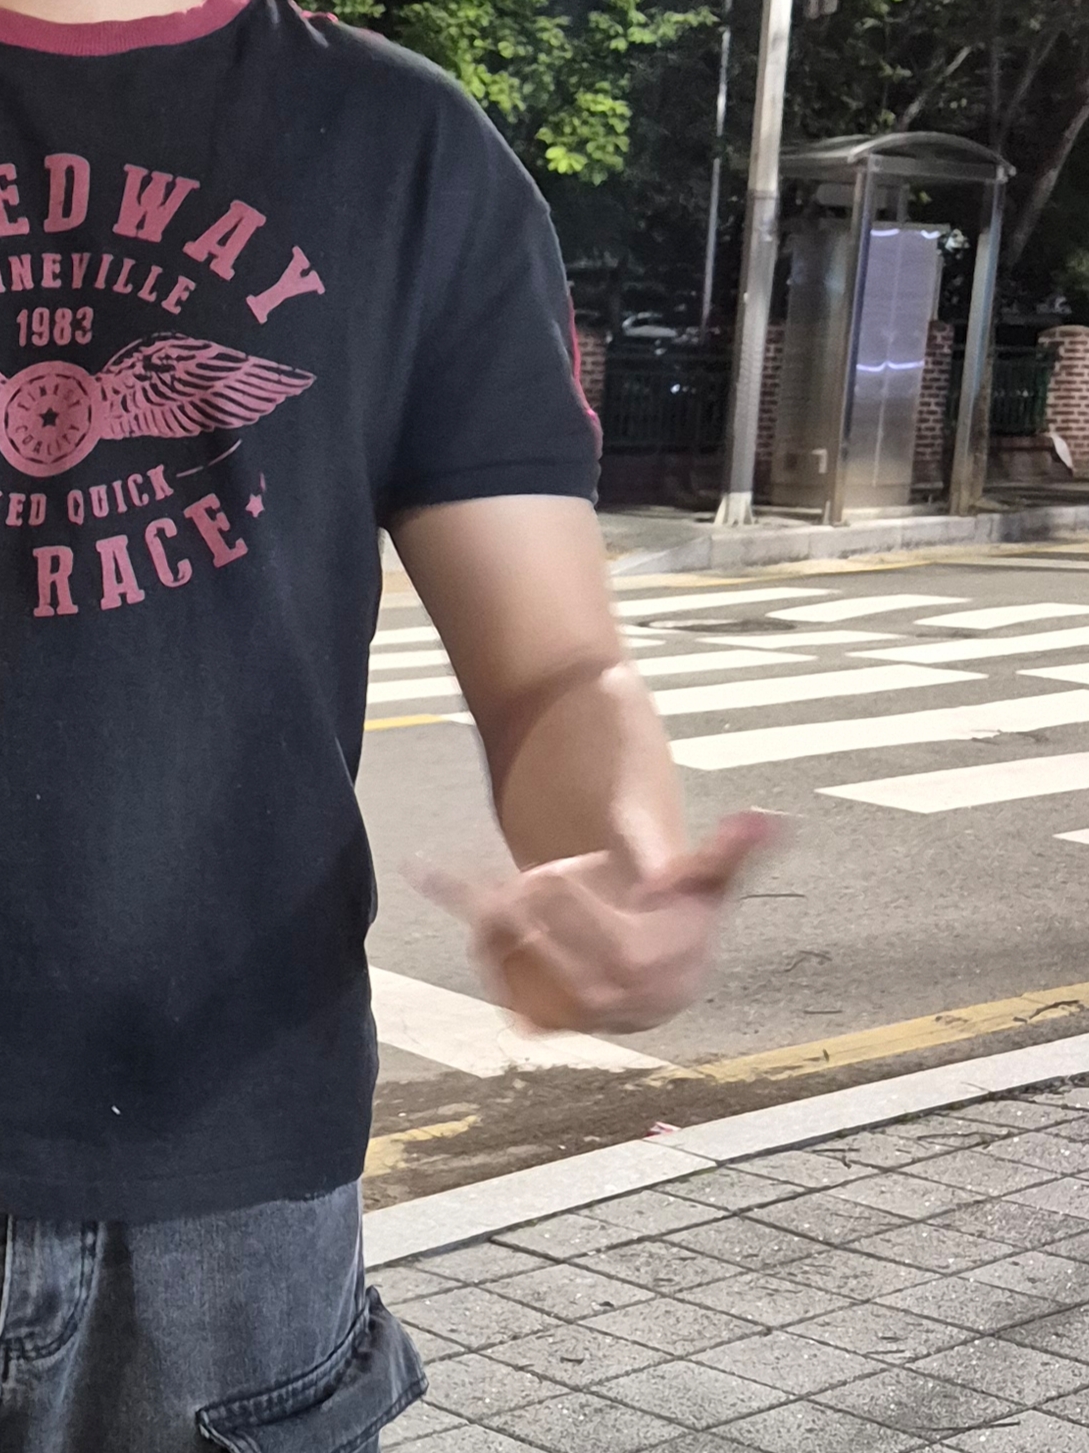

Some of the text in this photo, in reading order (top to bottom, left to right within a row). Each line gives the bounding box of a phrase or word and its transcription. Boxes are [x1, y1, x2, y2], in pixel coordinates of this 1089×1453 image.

[16, 306, 94, 347] 1983
[66, 464, 174, 525] QUICK
[32, 493, 248, 618] RACE
